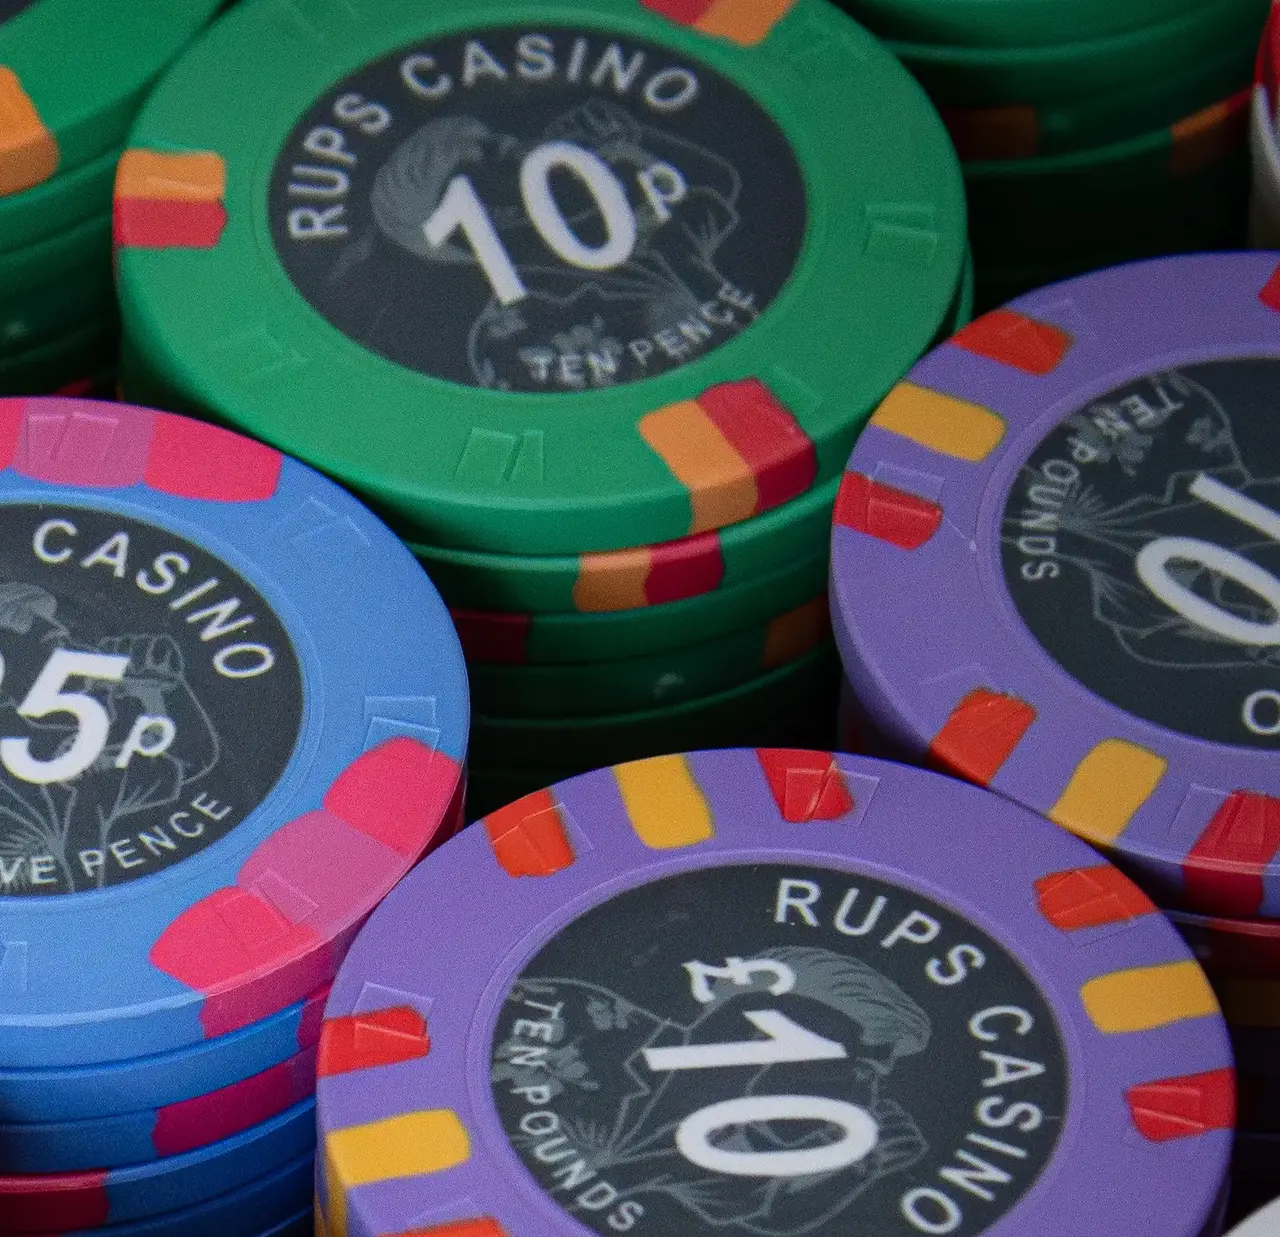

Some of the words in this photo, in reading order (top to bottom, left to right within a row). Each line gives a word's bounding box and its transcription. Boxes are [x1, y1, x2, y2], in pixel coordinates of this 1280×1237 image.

[287, 91, 393, 241] RUPS
[400, 33, 700, 113] CASINO
[422, 139, 687, 307] 10p
[522, 347, 618, 388] TEN
[628, 283, 758, 367] PENCE
[1016, 435, 1100, 581] POUNDS
[32, 518, 275, 680] CASINO
[78, 792, 233, 877] PENCE
[510, 998, 566, 1068] TEN
[641, 954, 880, 1177] £10
[774, 877, 987, 987] RUPS
[901, 1004, 1046, 1235] CASINO
[510, 1084, 646, 1232] POUNDS
